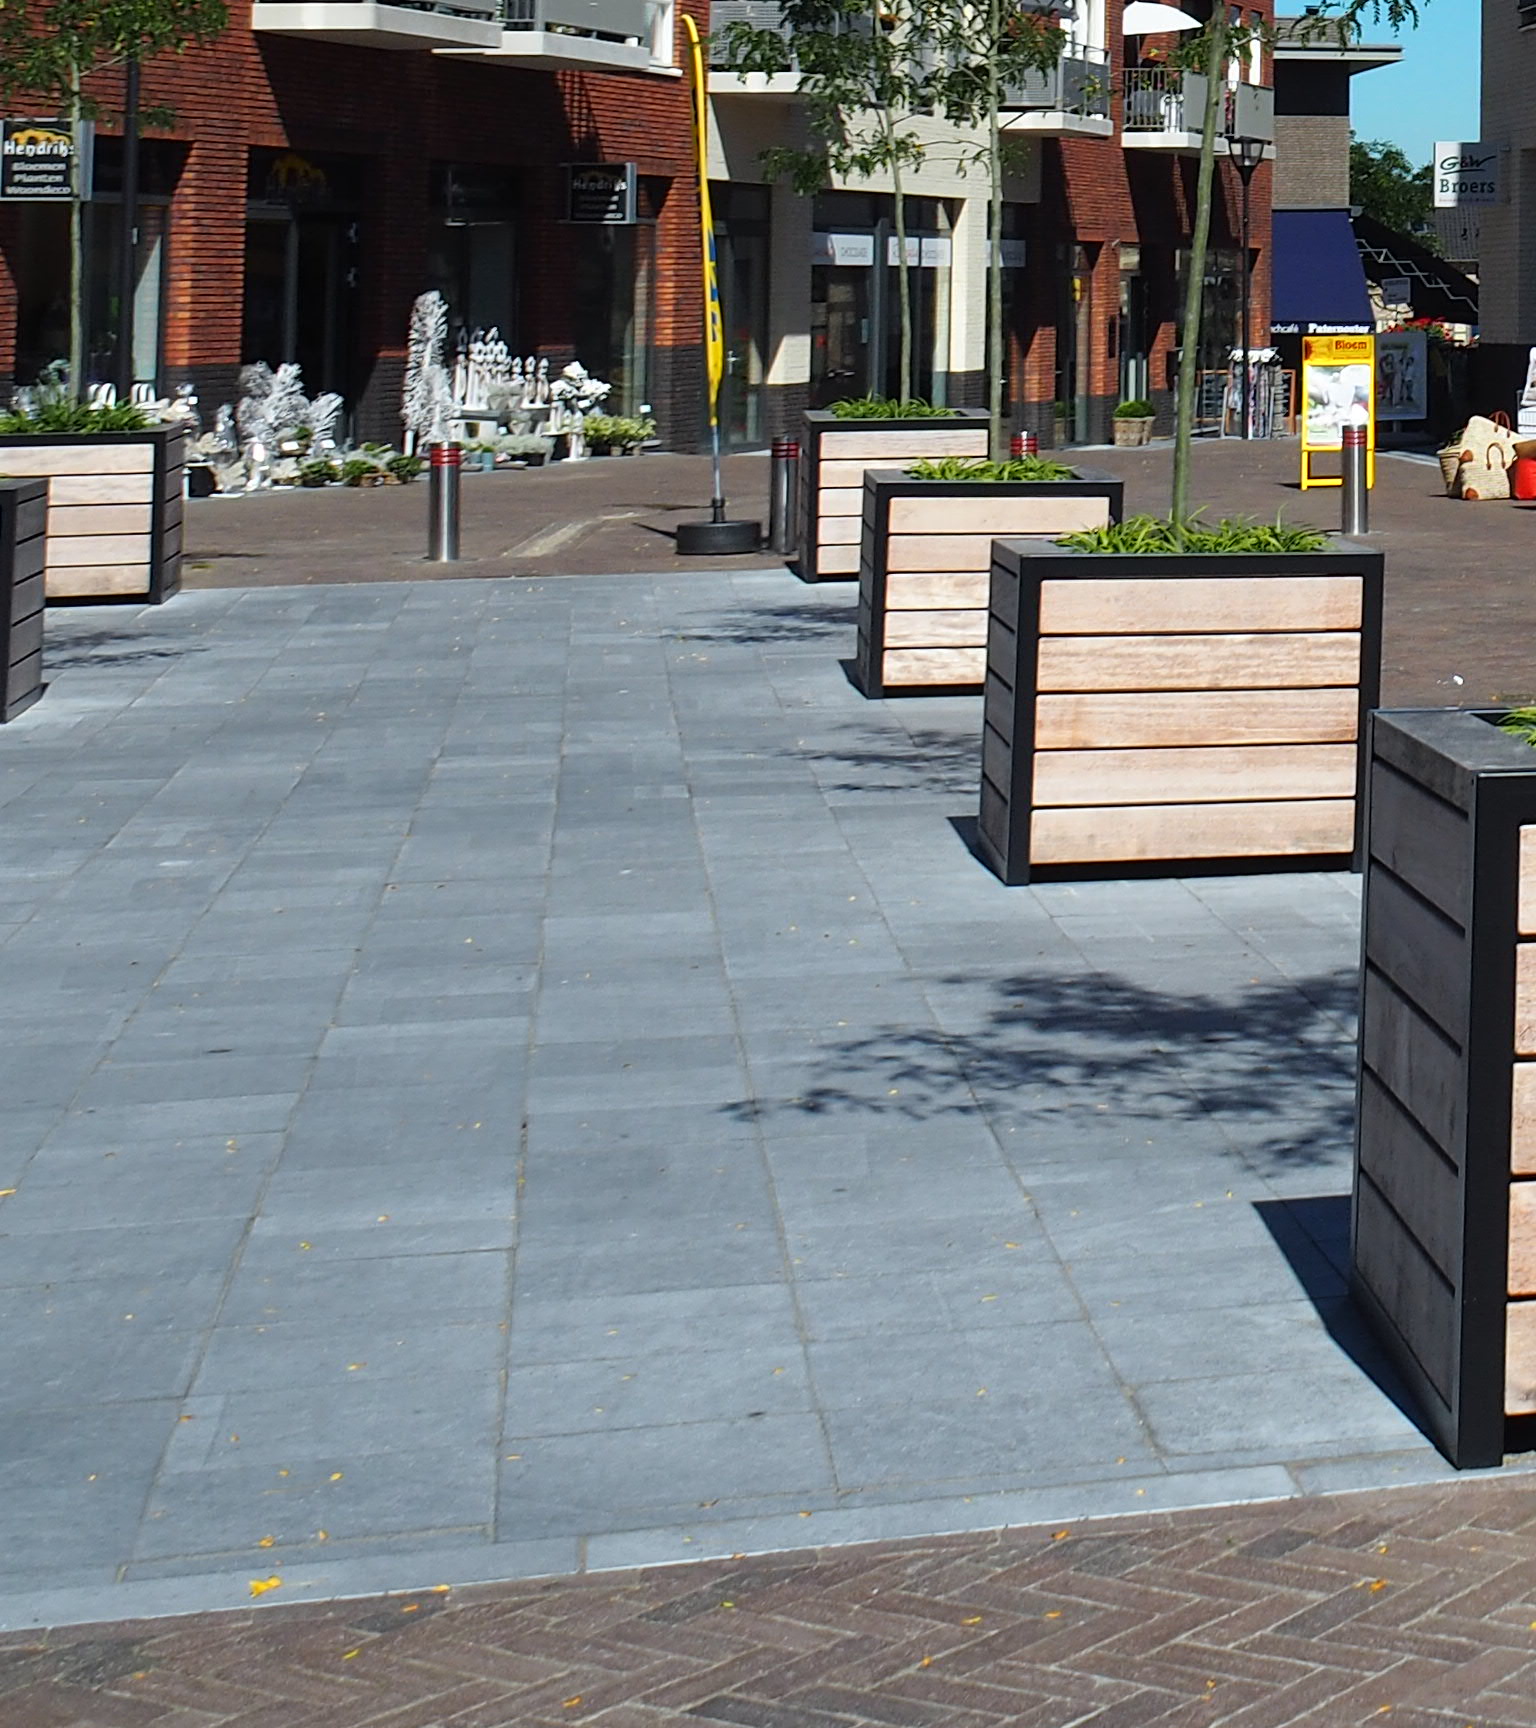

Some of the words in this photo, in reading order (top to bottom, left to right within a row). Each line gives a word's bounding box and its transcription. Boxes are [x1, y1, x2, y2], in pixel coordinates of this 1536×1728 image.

[1440, 155, 1497, 175] G&W
[1439, 178, 1496, 193] Broers
[1335, 340, 1367, 350] Bloem
